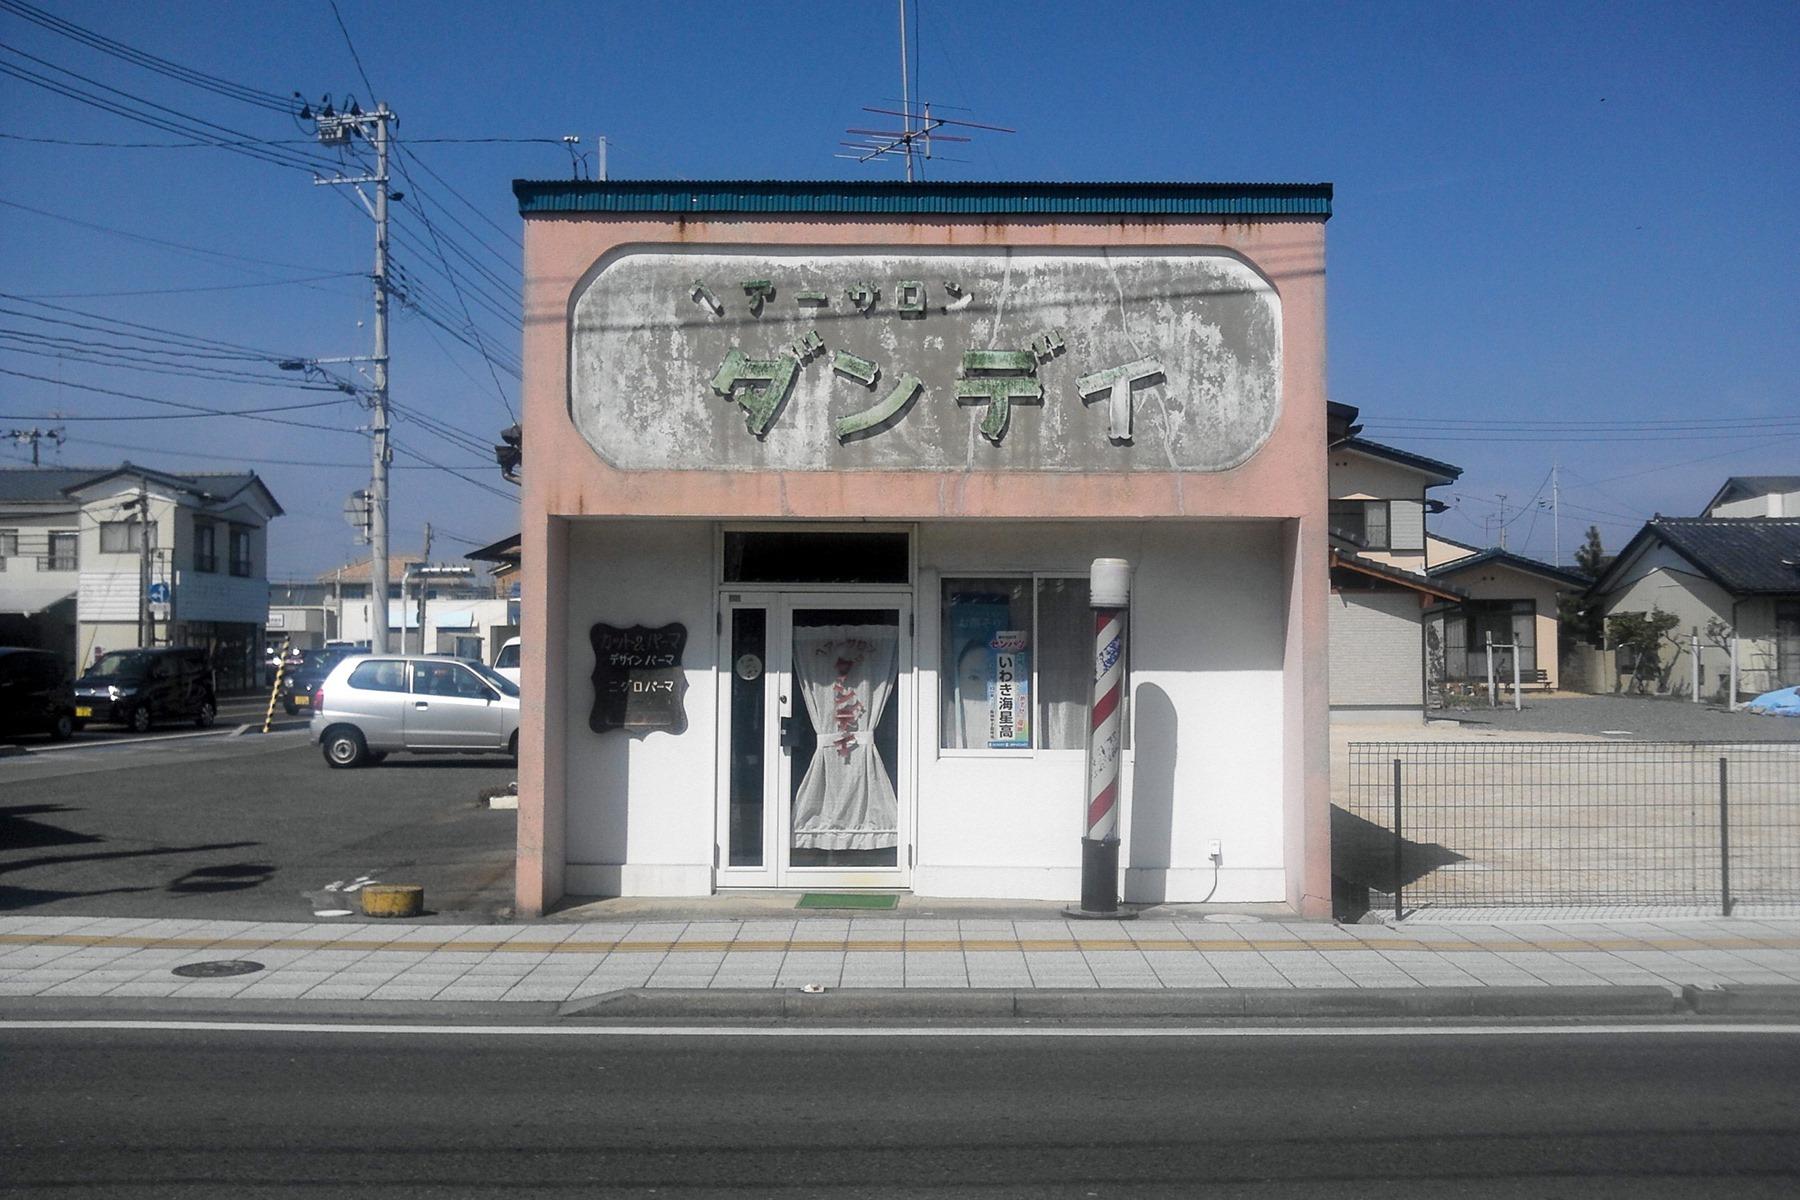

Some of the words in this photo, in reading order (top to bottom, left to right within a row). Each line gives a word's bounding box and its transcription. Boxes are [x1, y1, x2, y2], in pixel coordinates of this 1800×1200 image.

[689, 279, 973, 316] ヘアーサロン
[998, 656, 1013, 738] いわき海星高
